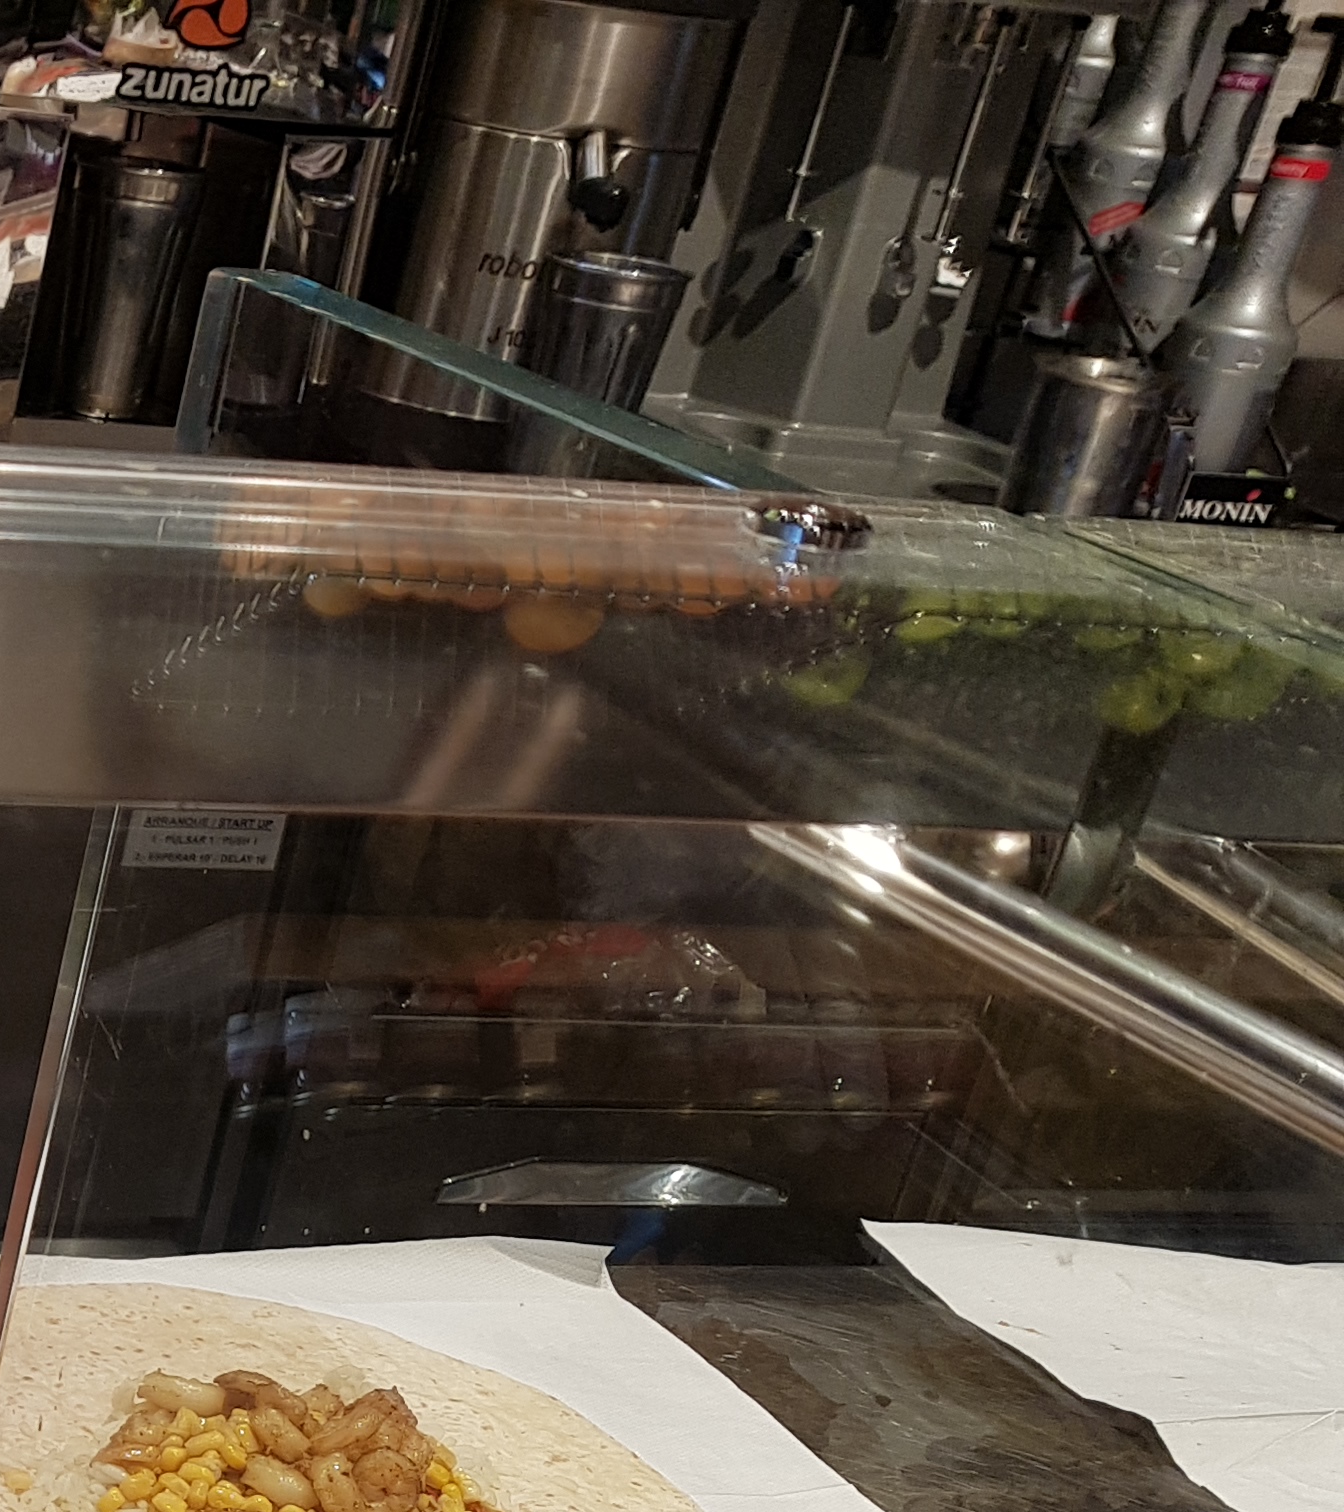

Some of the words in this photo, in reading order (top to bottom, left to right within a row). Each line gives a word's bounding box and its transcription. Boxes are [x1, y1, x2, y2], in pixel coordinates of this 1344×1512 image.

[118, 64, 268, 108] zunatur
[477, 252, 538, 281] robo
[1179, 499, 1274, 525] MONIN
[218, 817, 254, 831] START
